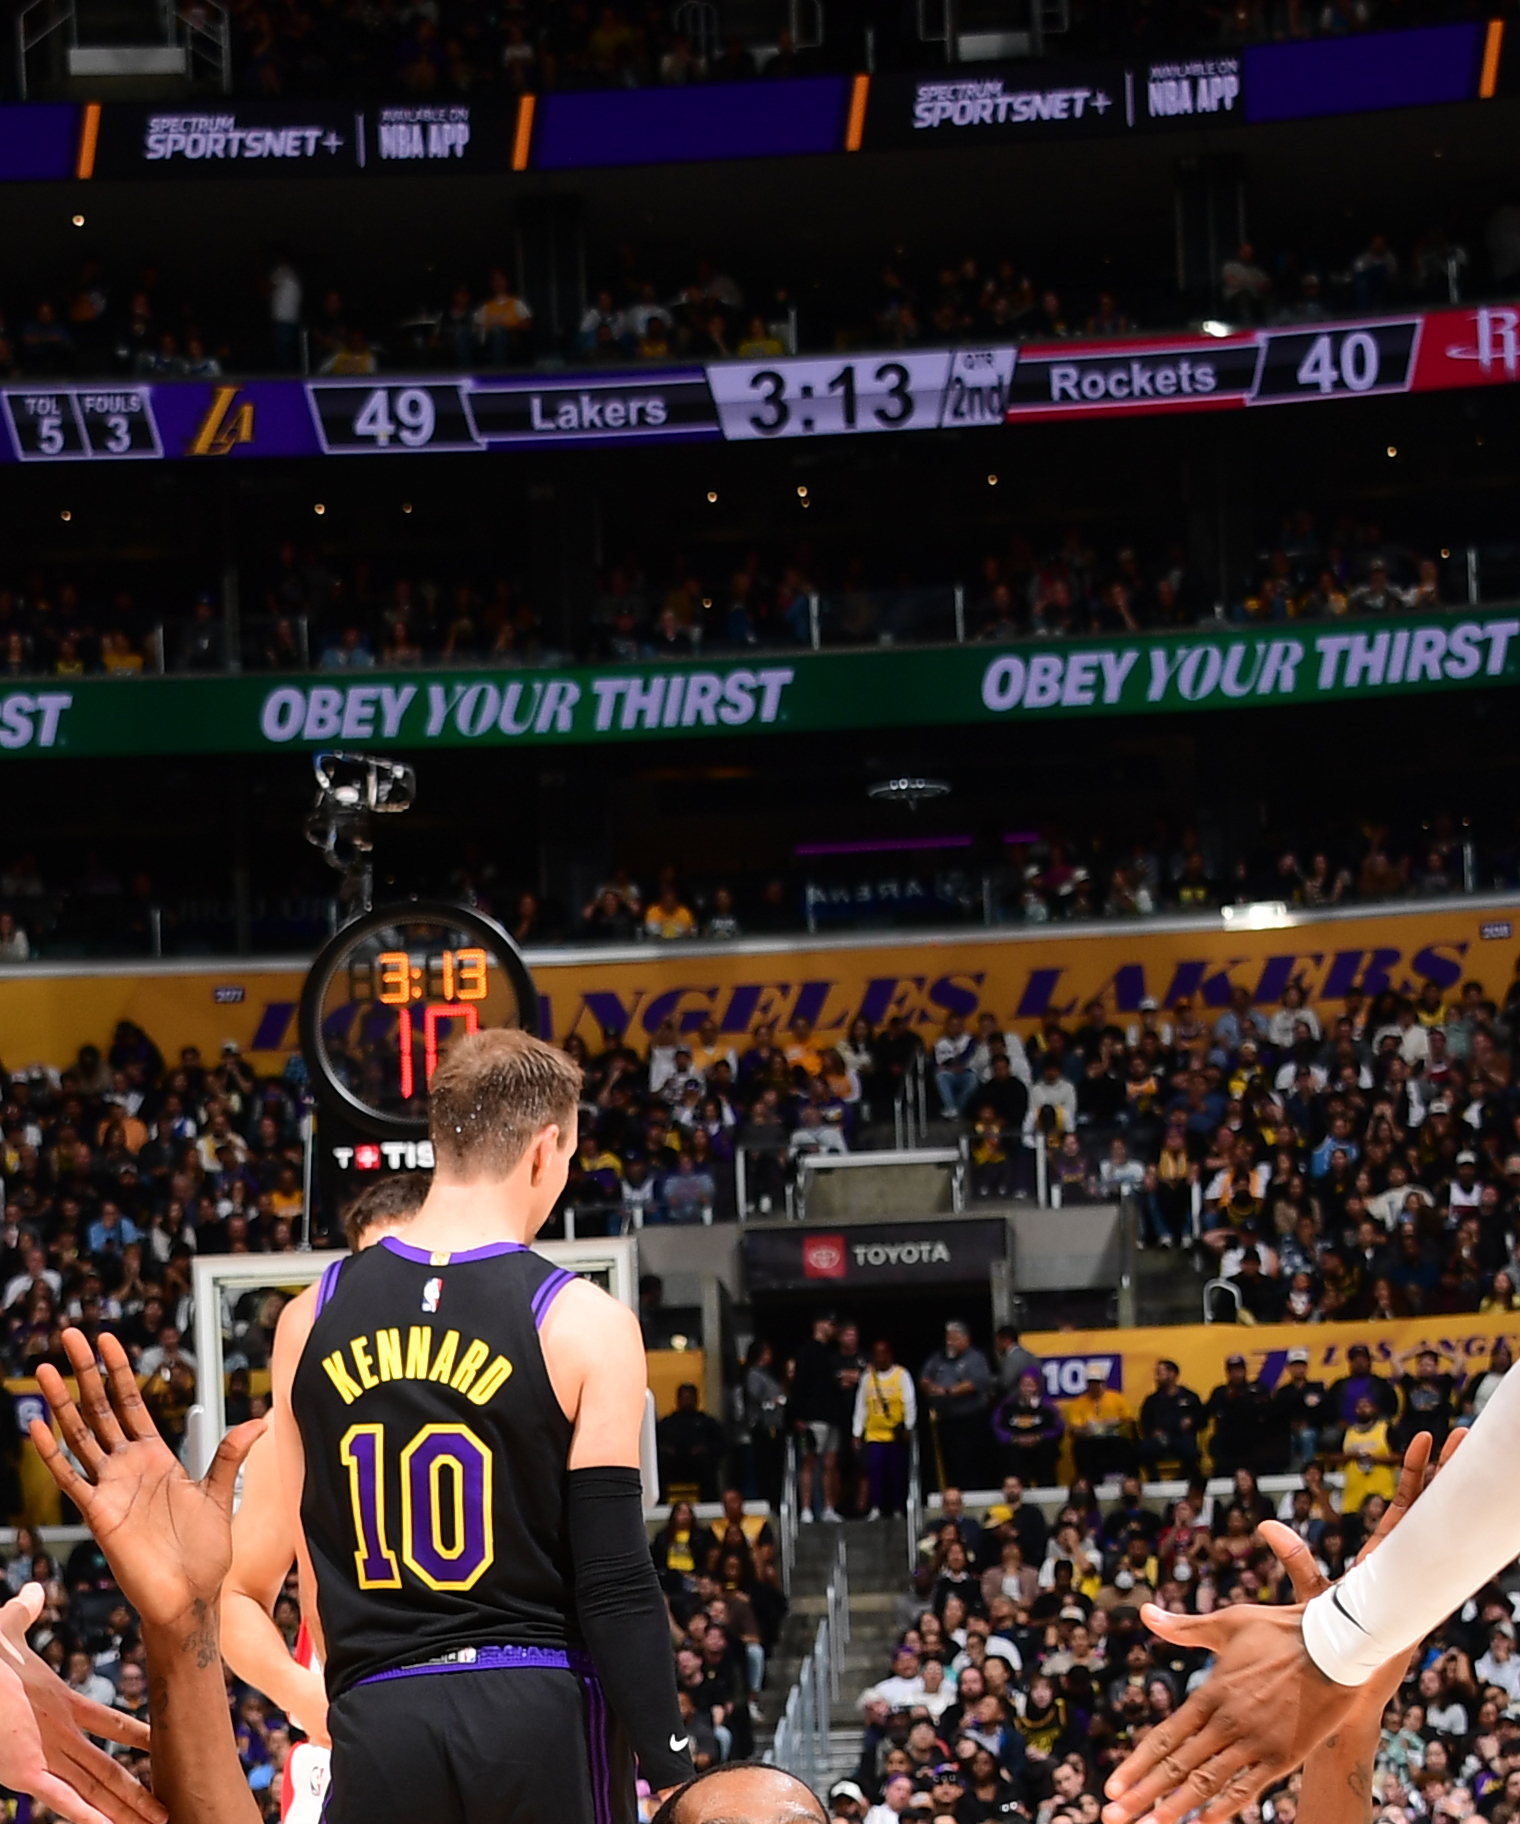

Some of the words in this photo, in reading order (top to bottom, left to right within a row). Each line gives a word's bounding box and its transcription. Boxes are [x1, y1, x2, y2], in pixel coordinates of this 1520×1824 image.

[1151, 60, 1213, 77] AVAILABLE
[1218, 59, 1239, 73] ON
[913, 90, 1112, 128] SPORTSNET+
[917, 81, 1004, 105] SPECTRUM
[1148, 77, 1190, 117] NBA
[1195, 75, 1239, 113] APP
[149, 116, 235, 135] SPECTRUM
[382, 108, 442, 125] AVAILABLE
[446, 108, 469, 121] ON
[145, 127, 344, 160] SPORTSNET+
[379, 124, 425, 158] NBA
[428, 122, 470, 158] APP
[1050, 360, 1218, 401] Rockets
[1298, 333, 1379, 394] 40
[25, 397, 60, 415] TOL
[84, 395, 141, 413] FOULS
[354, 390, 434, 446] 49
[530, 395, 668, 433] Lakers
[747, 364, 915, 435] 3:13
[38, 418, 63, 453] 5
[105, 415, 131, 451] 3
[981, 650, 1139, 712] OBEY
[1147, 640, 1306, 703] YOUR
[262, 684, 416, 741] OBEY
[425, 679, 585, 737] YOUR
[592, 668, 795, 731] THIRST
[379, 947, 488, 1004] 3:13
[1015, 940, 1470, 1020] LAKERS
[381, 1140, 434, 1170] TIS
[853, 1239, 951, 1267] TOYOTA
[322, 1326, 514, 1406] KENNARD
[339, 1422, 495, 1592] 10
